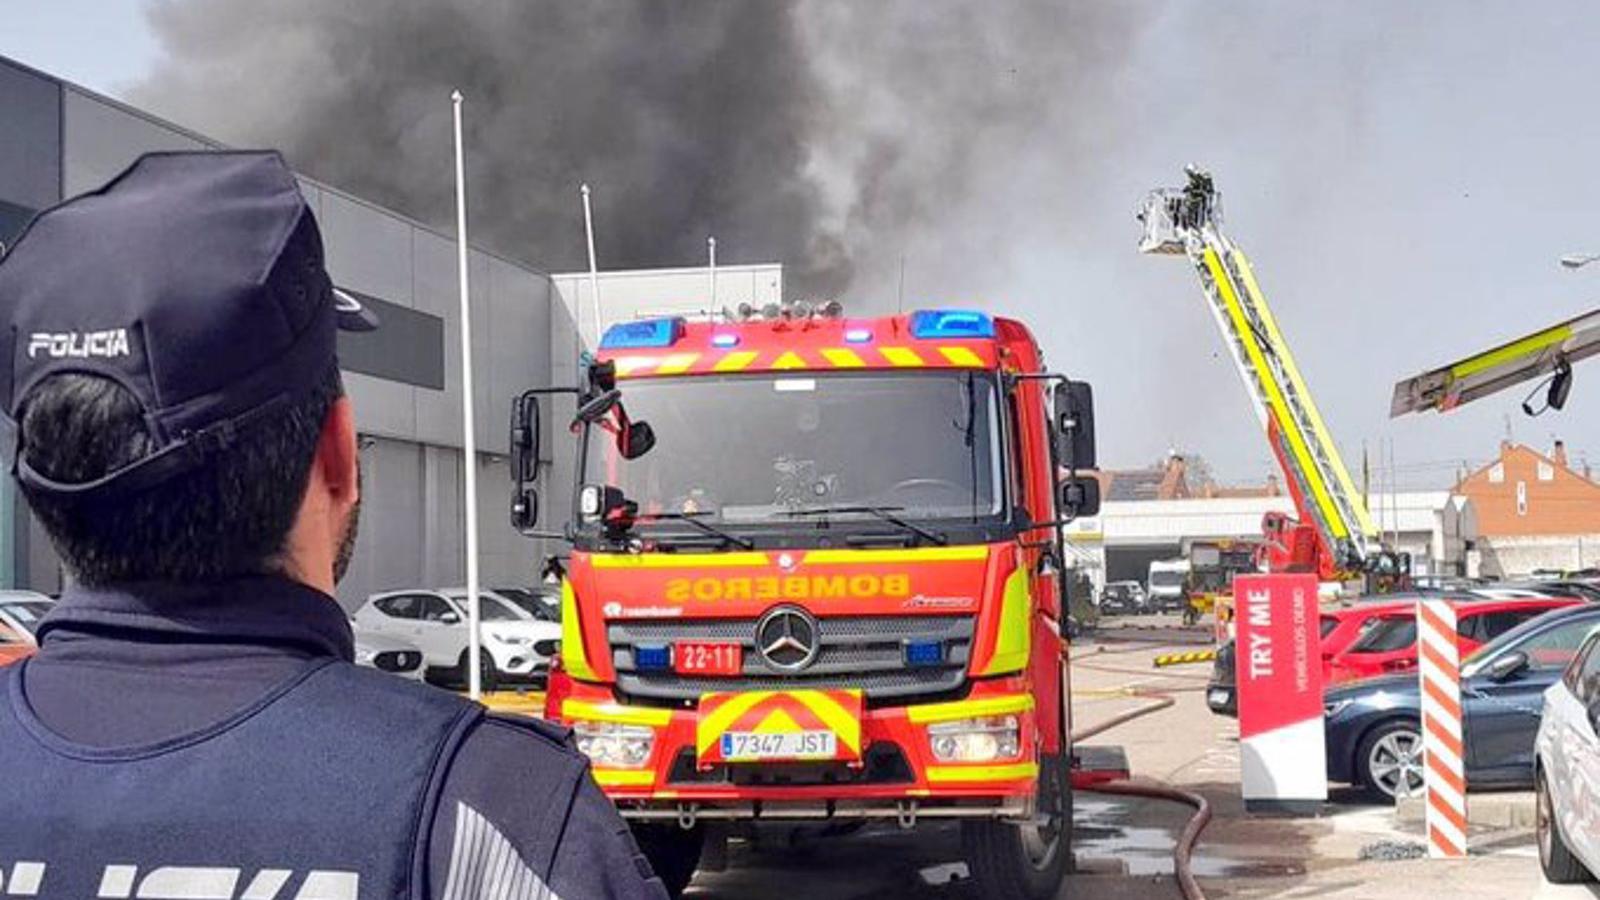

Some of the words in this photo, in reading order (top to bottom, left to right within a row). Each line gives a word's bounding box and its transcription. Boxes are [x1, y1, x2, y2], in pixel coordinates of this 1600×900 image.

[1247, 586, 1272, 627] ME
[684, 645, 735, 670] 22-11
[1249, 632, 1274, 681] TRY
[736, 734, 784, 754] 7347
[795, 733, 829, 753] JST
